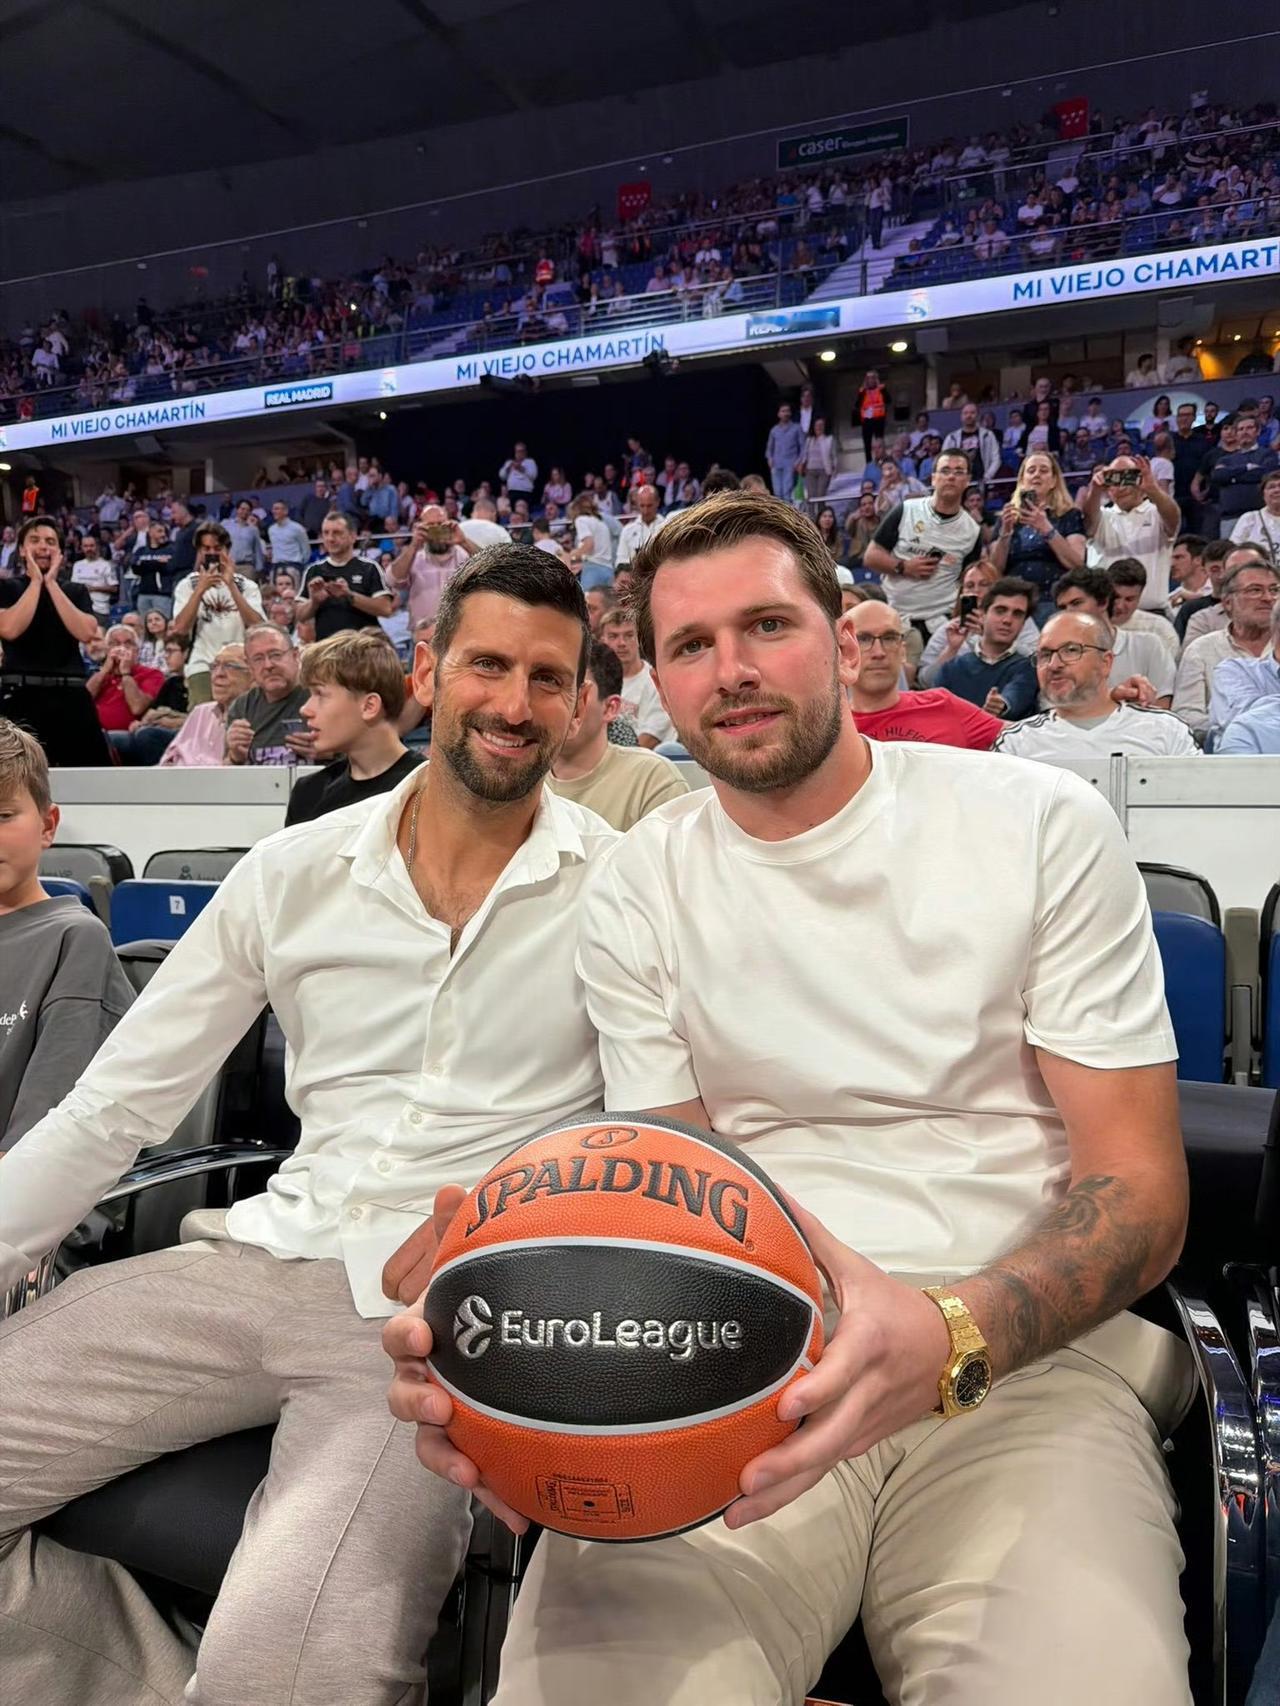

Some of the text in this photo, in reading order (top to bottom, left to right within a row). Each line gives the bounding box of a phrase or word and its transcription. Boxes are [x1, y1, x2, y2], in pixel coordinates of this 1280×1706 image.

[799, 137, 842, 156] caser
[1013, 244, 1280, 301] MI VIEJO CHAMART
[457, 331, 665, 380] MI VIEJO CHAMARTÍN
[51, 401, 205, 439] MI VIEJO CHAMARTÍN
[465, 1156, 749, 1244] SPALDING
[501, 1310, 742, 1361] EuroLeague
